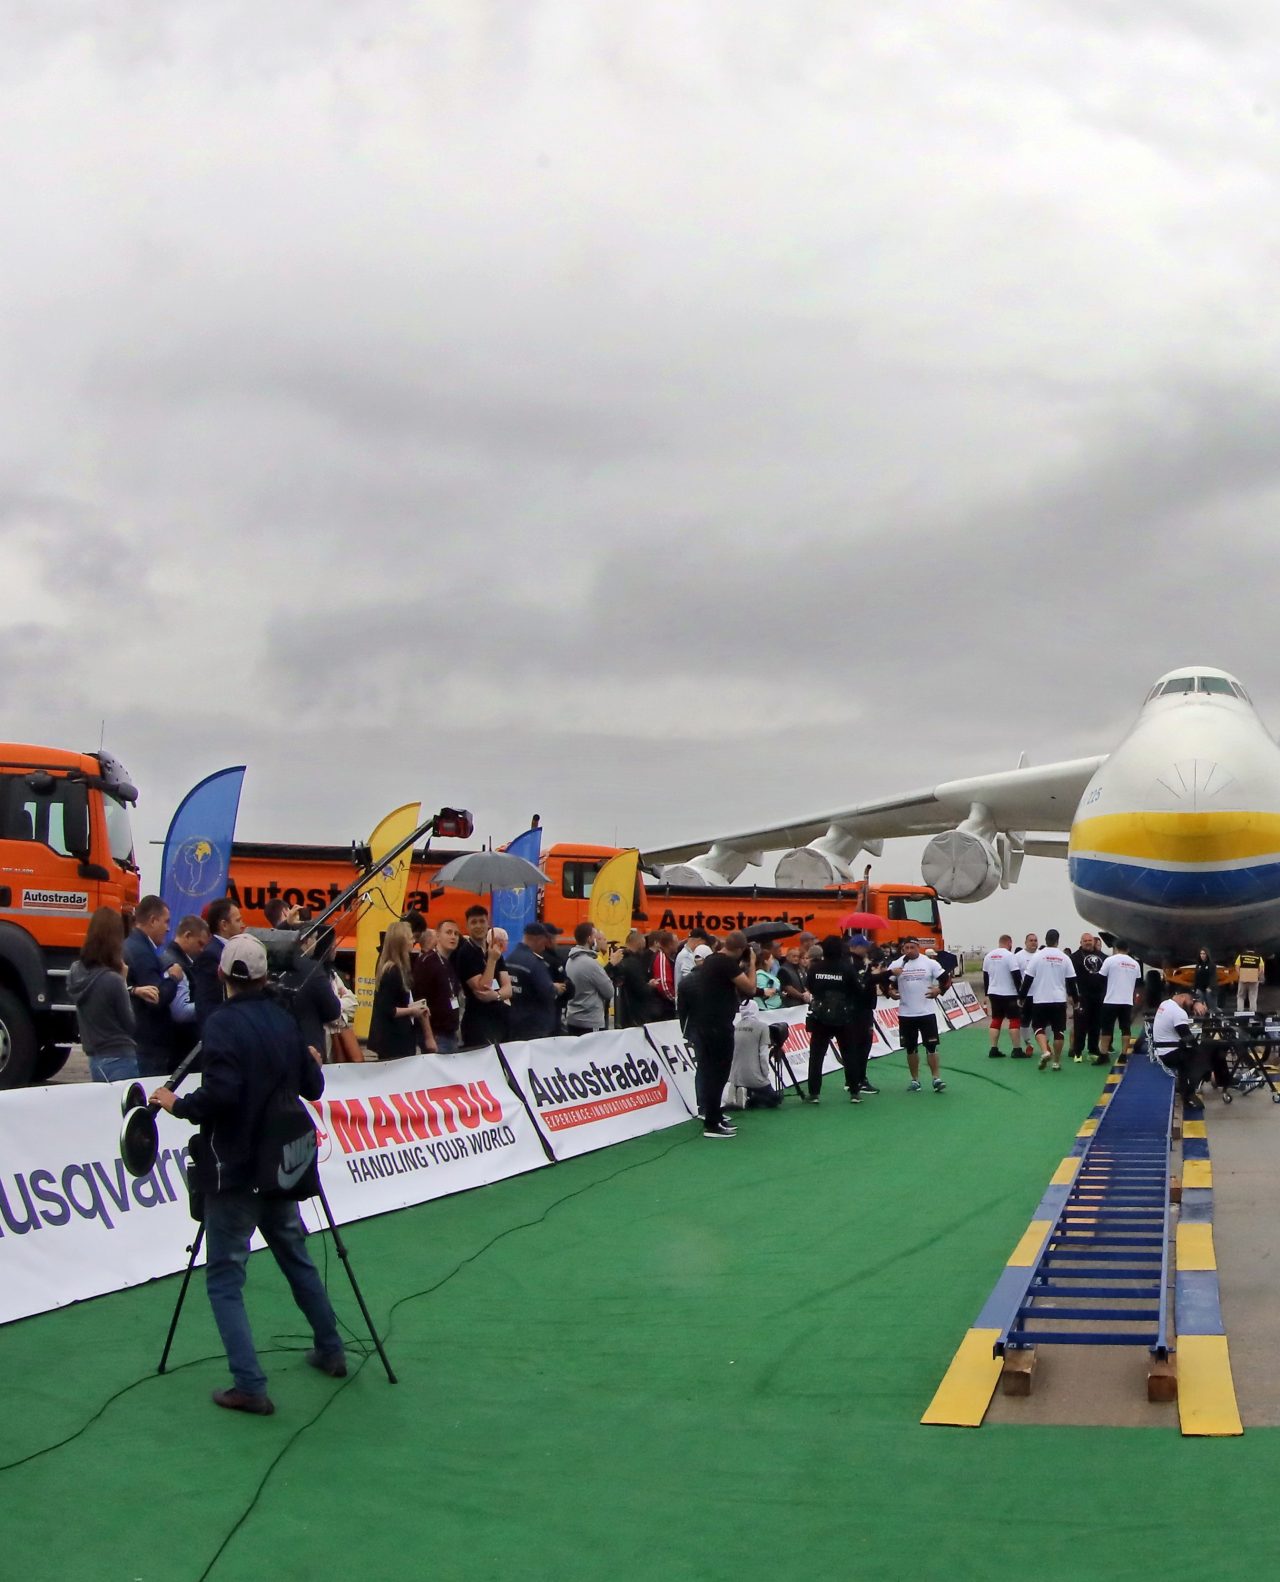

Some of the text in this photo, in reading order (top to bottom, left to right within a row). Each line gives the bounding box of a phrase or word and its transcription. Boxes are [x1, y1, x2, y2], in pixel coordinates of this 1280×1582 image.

[24, 891, 82, 904] Autostrada
[226, 878, 429, 913] Autosta
[528, 1053, 655, 1107] Autostrada
[328, 1080, 504, 1154] MANITOU
[346, 1125, 516, 1184] HANDLING YOUR WORLD
[0, 1146, 191, 1239] usqvarn
